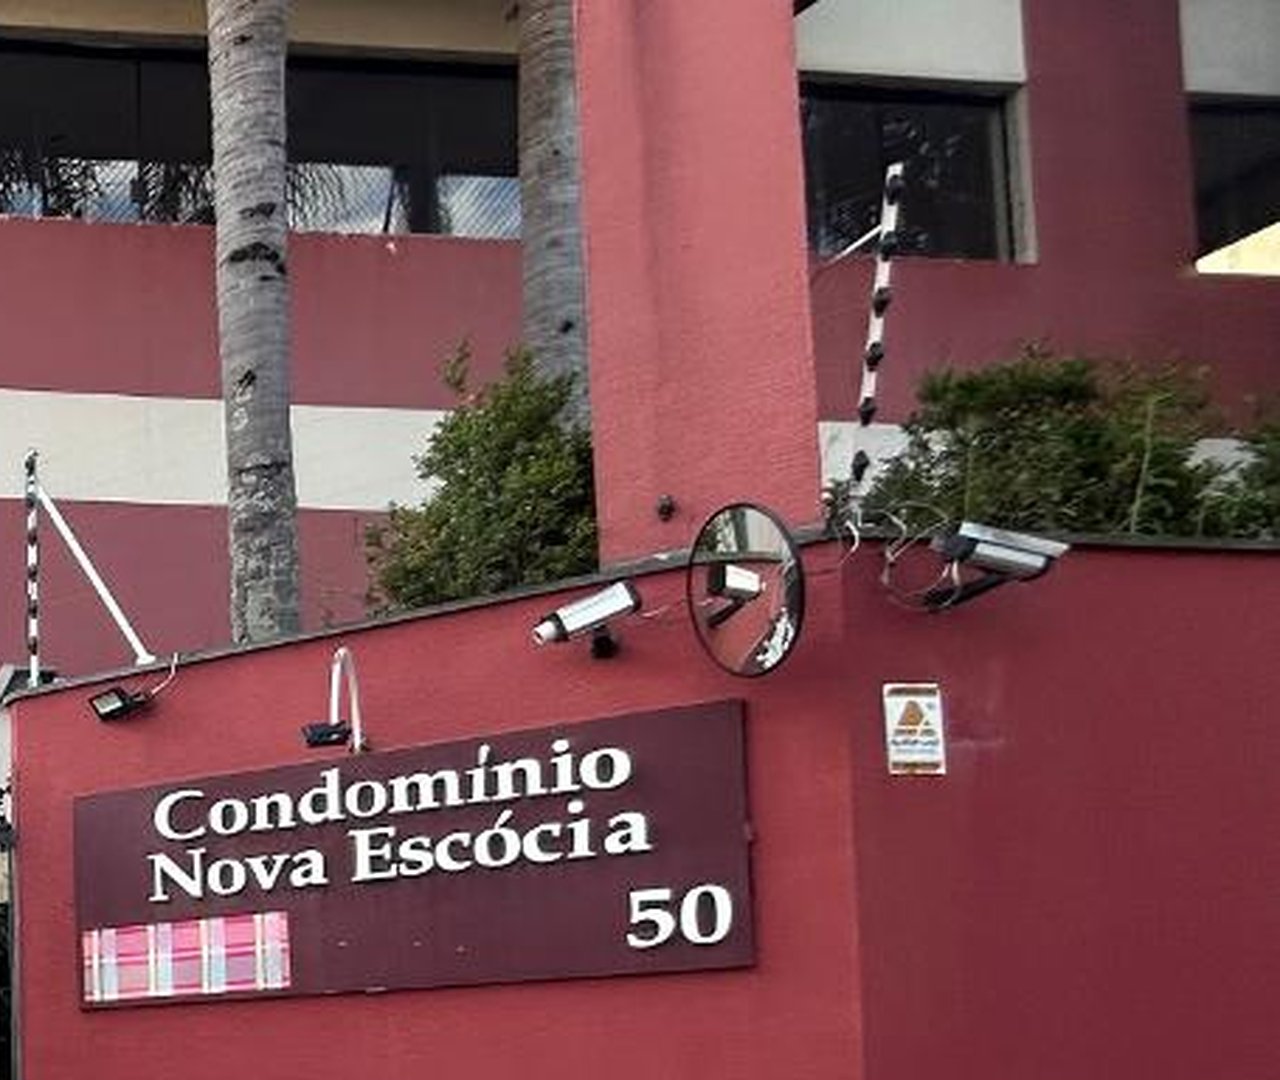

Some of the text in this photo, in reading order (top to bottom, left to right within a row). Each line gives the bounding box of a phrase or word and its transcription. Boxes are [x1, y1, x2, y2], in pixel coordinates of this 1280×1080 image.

[153, 738, 633, 841] Condomínio
[146, 800, 653, 902] Nova Escócia
[625, 884, 733, 949] 50
